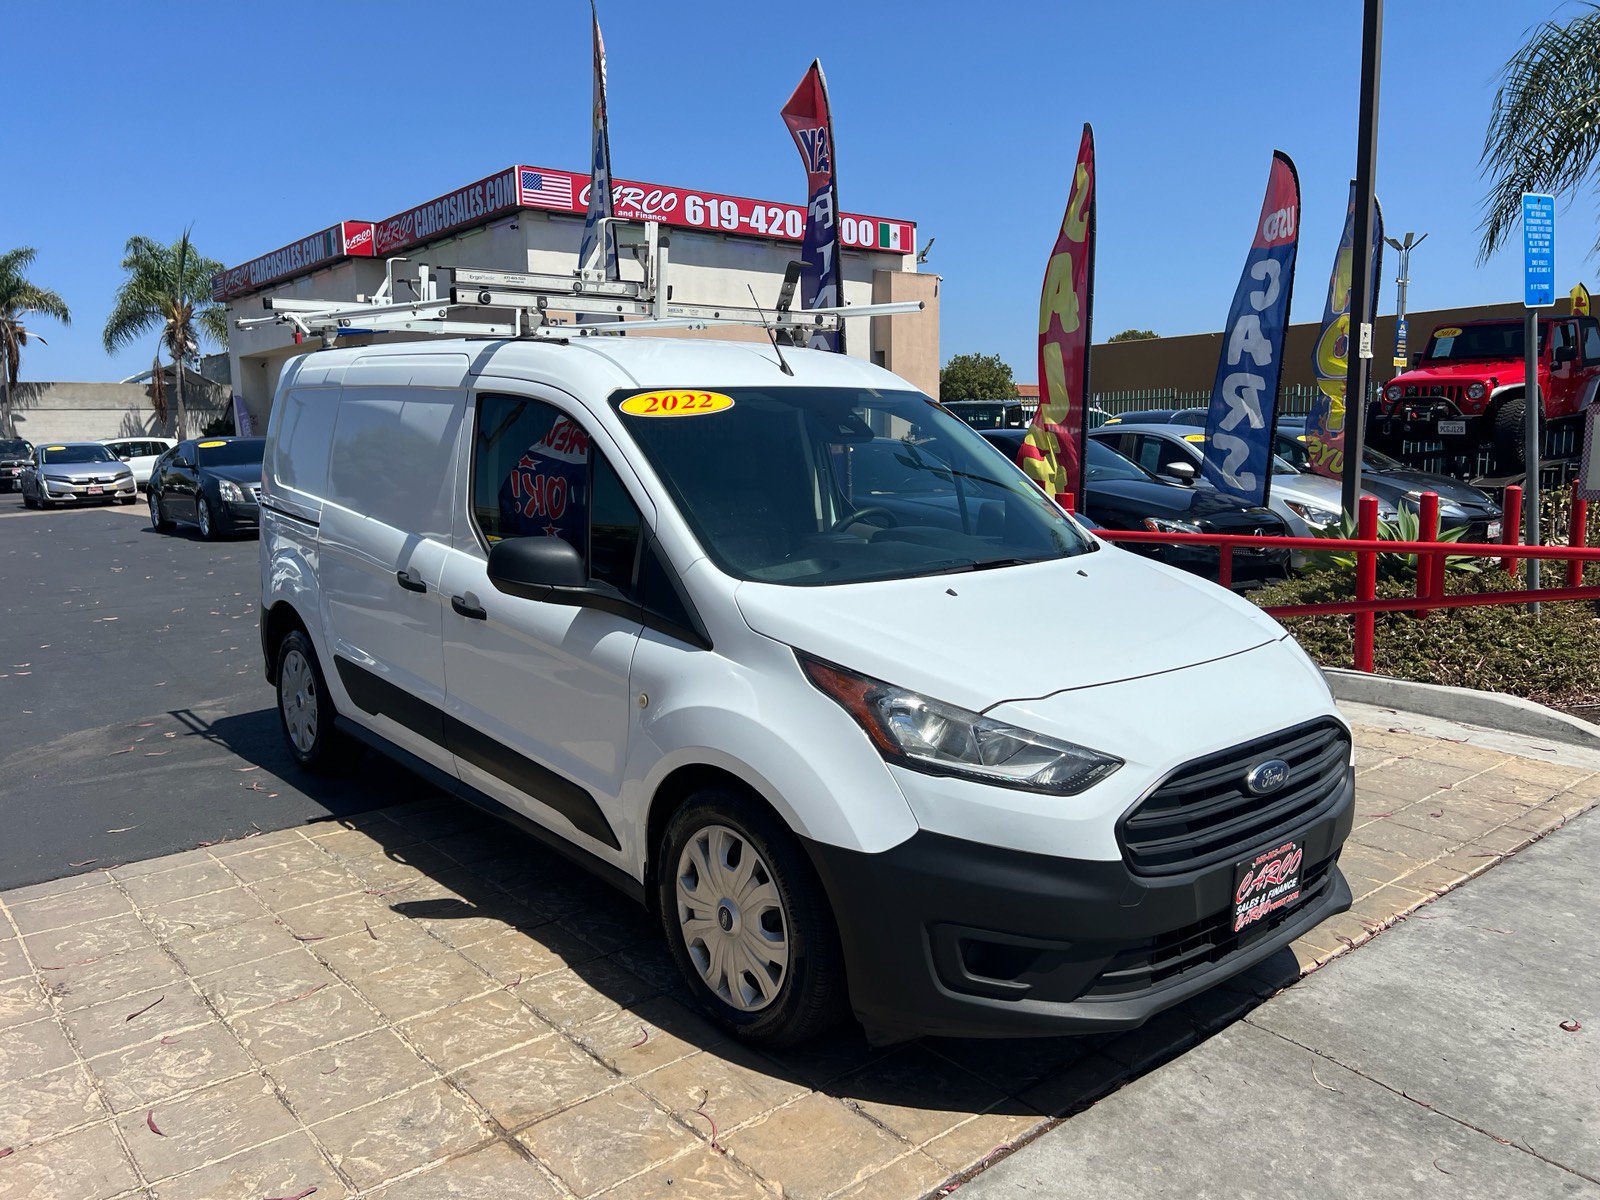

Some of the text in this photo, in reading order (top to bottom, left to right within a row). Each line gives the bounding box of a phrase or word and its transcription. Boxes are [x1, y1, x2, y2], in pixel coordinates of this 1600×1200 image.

[376, 172, 516, 248] CARCO CARCOSALES.COM
[618, 209, 667, 222] and Finance
[345, 229, 371, 249] CARCO
[224, 234, 324, 292] CARCO CARCOSALES.COM
[643, 393, 713, 413] 2022
[1262, 766, 1284, 788] Ford
[1236, 848, 1302, 904] CARCO
[1236, 896, 1259, 915] SALES
[1260, 893, 1267, 902] &
[1267, 877, 1298, 899] FINANCE
